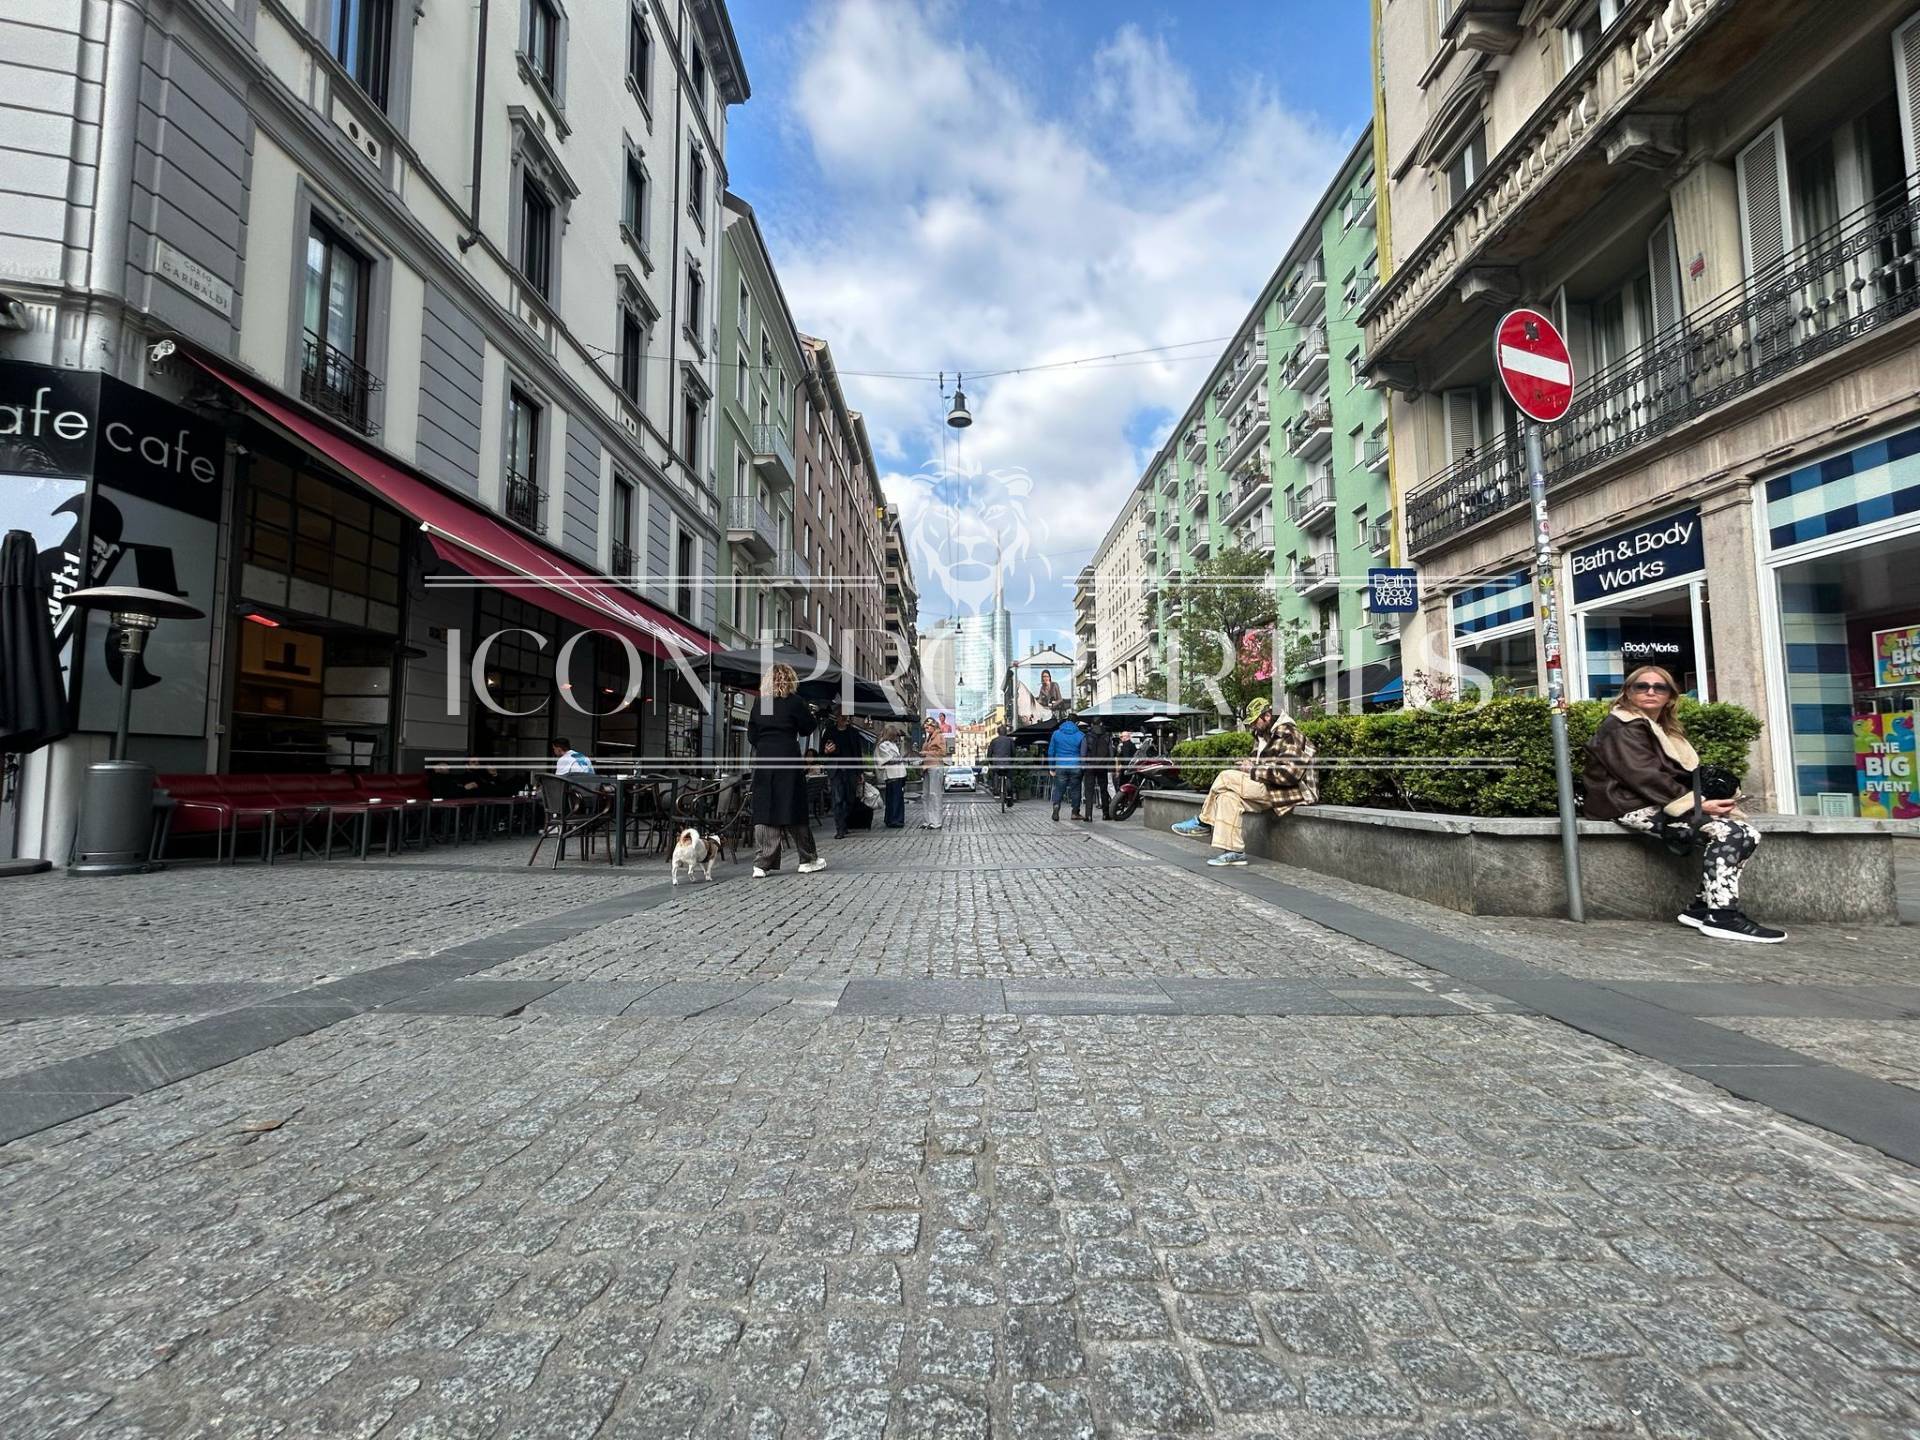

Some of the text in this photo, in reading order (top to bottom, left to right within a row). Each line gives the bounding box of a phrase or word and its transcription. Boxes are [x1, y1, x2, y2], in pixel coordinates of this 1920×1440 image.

[162, 261, 228, 309] GARIBALDI
[105, 422, 215, 483] cafe
[1572, 521, 1693, 575] Bath & Body
[1374, 573, 1412, 588] Bath
[1599, 560, 1664, 591] Works
[1375, 596, 1413, 606] Works
[1624, 641, 1680, 655] Body Works
[1870, 742, 1900, 754] THE
[1865, 756, 1911, 777] BIG
[1866, 781, 1912, 792] EVENT
